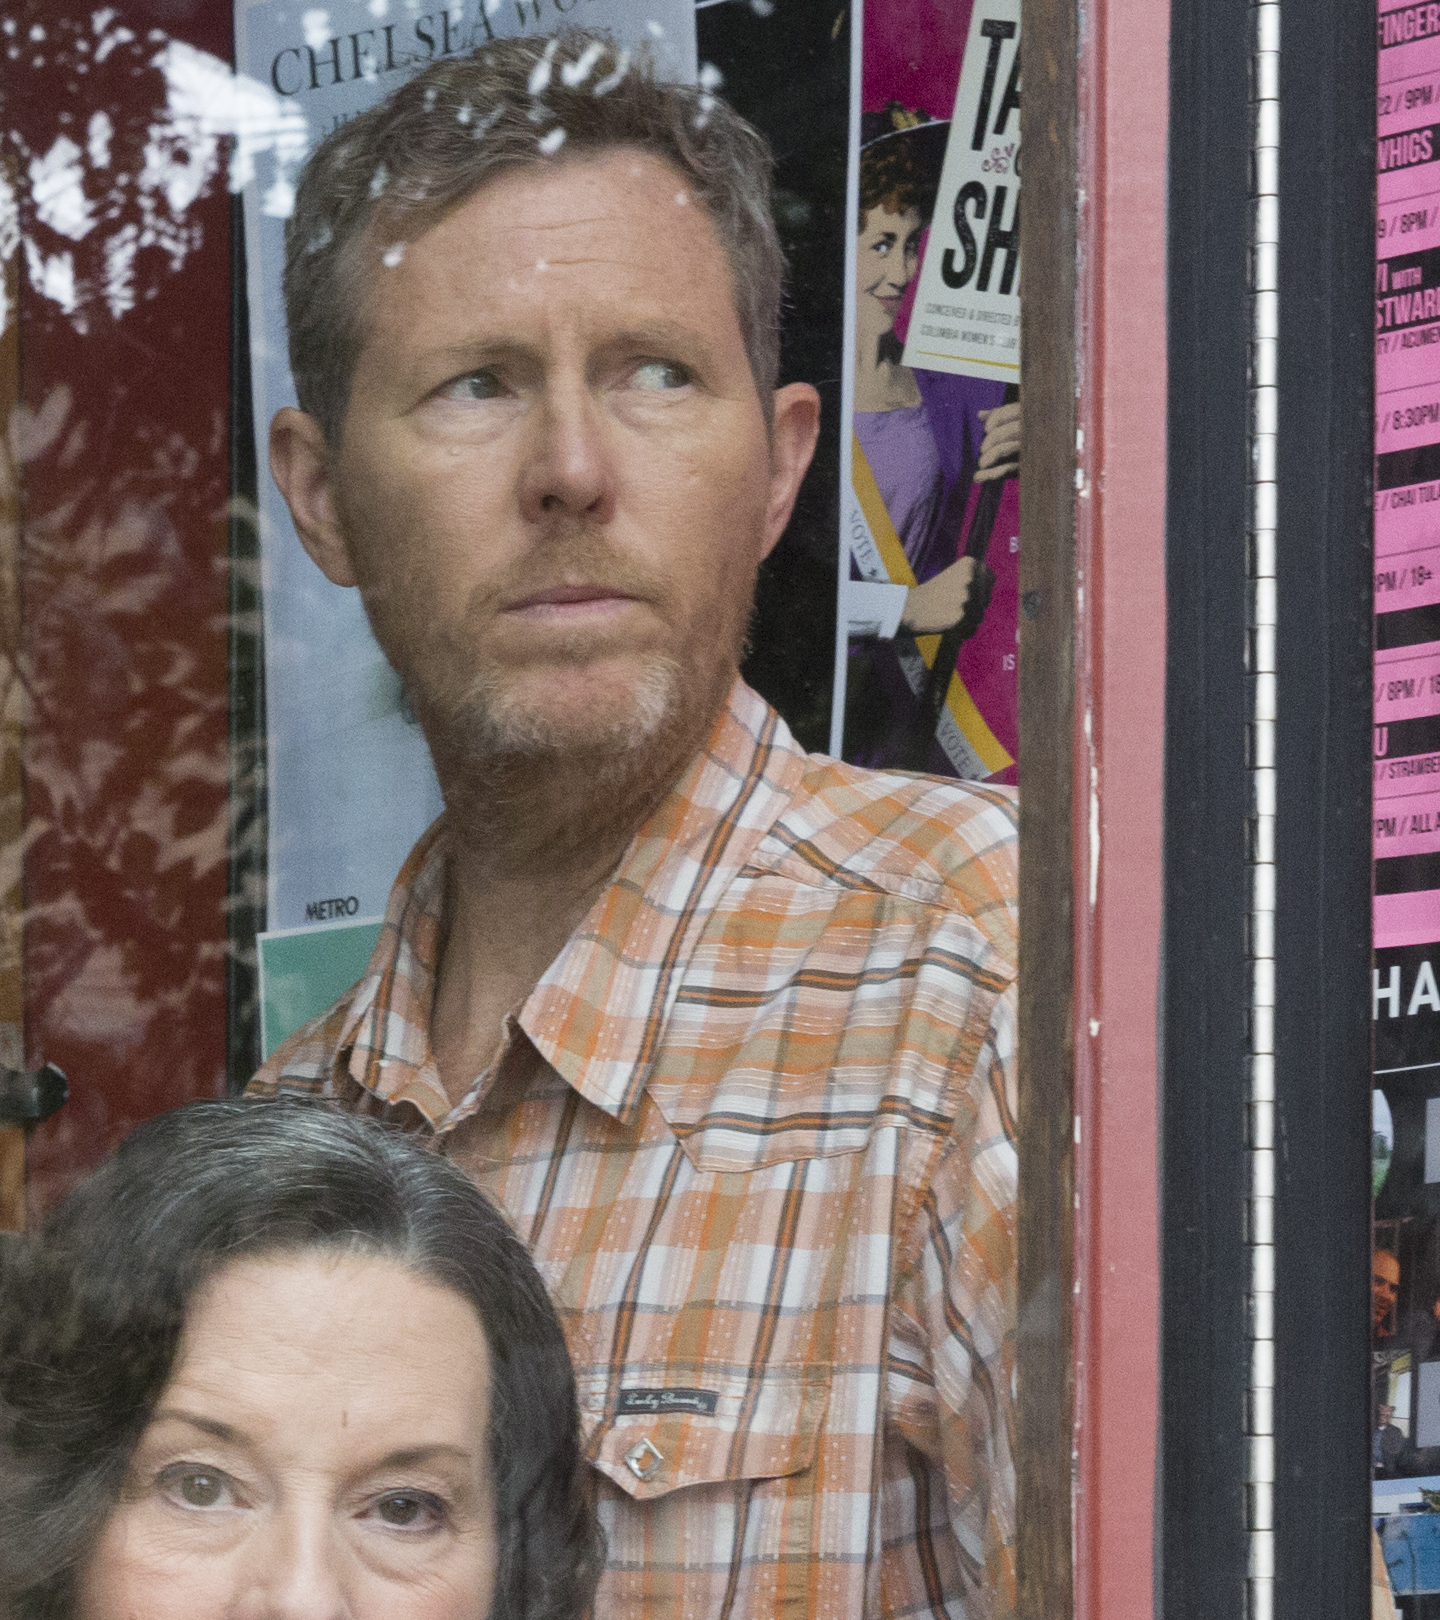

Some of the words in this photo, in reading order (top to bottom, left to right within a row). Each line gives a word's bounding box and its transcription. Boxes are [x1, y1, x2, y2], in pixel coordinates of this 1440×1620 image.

[1405, 84, 1434, 110] 9PM
[941, 180, 1020, 297] SH
[1392, 401, 1440, 431] 8:30PM
[1386, 677, 1416, 702] 8PM
[1410, 813, 1433, 834] ALL
[305, 896, 359, 922] METRO
